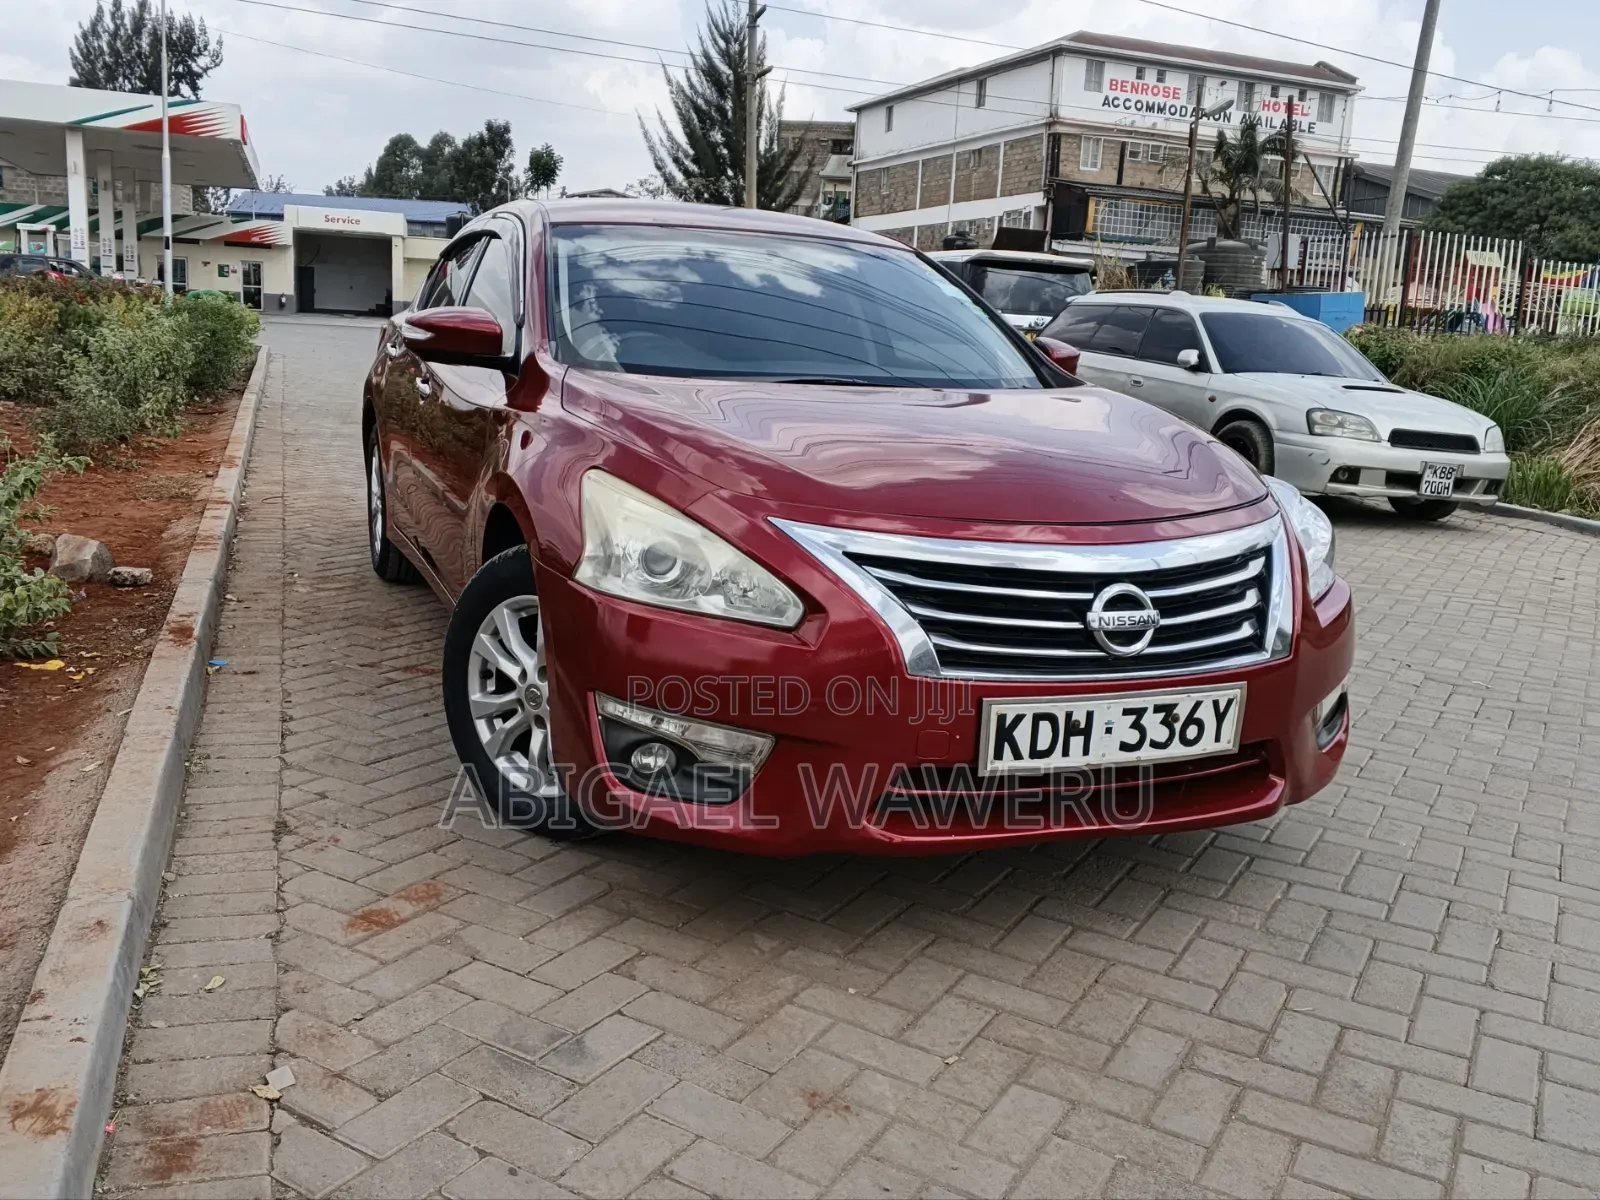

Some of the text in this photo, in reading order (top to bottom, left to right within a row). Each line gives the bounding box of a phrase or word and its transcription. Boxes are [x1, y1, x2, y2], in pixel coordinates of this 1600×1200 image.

[1109, 78, 1310, 116] BENROSE HOTEL
[324, 214, 361, 225] Service
[1432, 465, 1454, 480] KBB
[1424, 480, 1451, 496] 700H
[1097, 614, 1157, 628] NISSAN
[993, 697, 1235, 761] KDH 336Y
